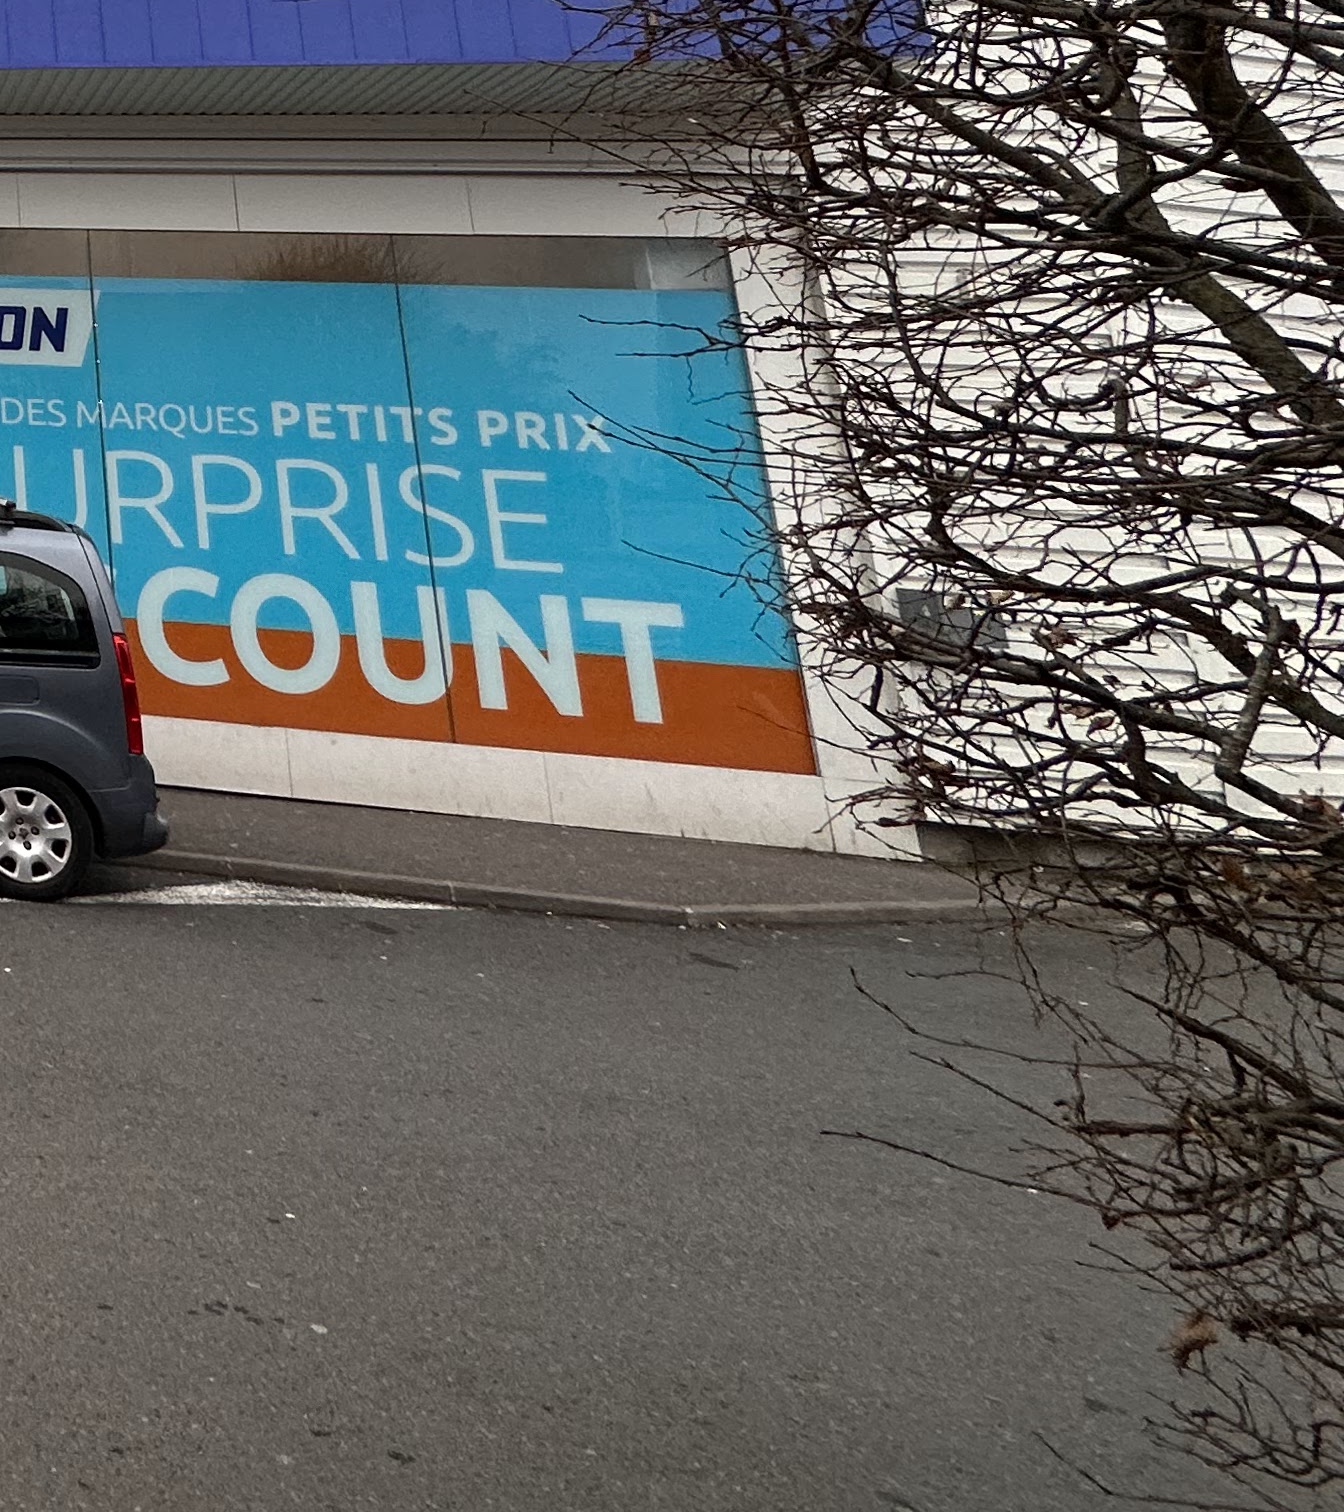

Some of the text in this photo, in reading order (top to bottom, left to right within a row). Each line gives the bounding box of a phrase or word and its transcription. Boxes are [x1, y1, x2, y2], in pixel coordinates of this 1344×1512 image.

[76, 398, 259, 438] MARQUES
[272, 399, 458, 447] PETITS
[477, 409, 612, 454] PRIX
[136, 565, 683, 725] COUNT
